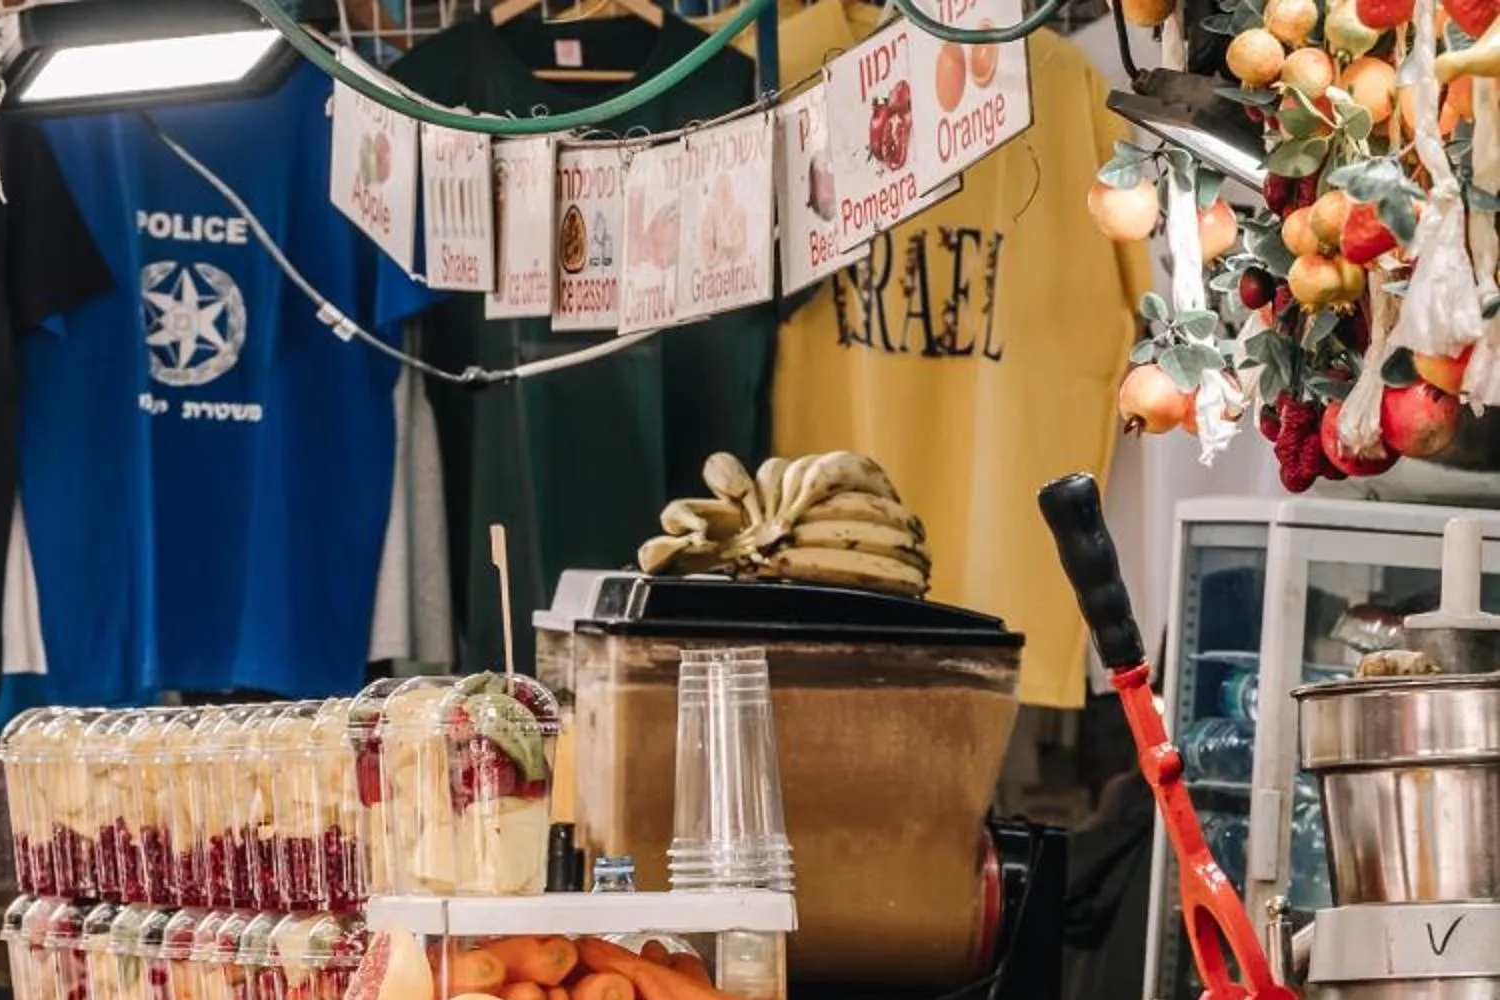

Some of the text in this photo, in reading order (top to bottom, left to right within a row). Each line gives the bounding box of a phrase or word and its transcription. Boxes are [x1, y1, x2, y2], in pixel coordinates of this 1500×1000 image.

[936, 93, 1006, 163] Orange
[135, 209, 248, 244] POLICE
[351, 174, 391, 235] Apple
[841, 172, 918, 236] Pomegra
[440, 243, 479, 284] Shakes
[690, 255, 758, 304] Grapefruit
